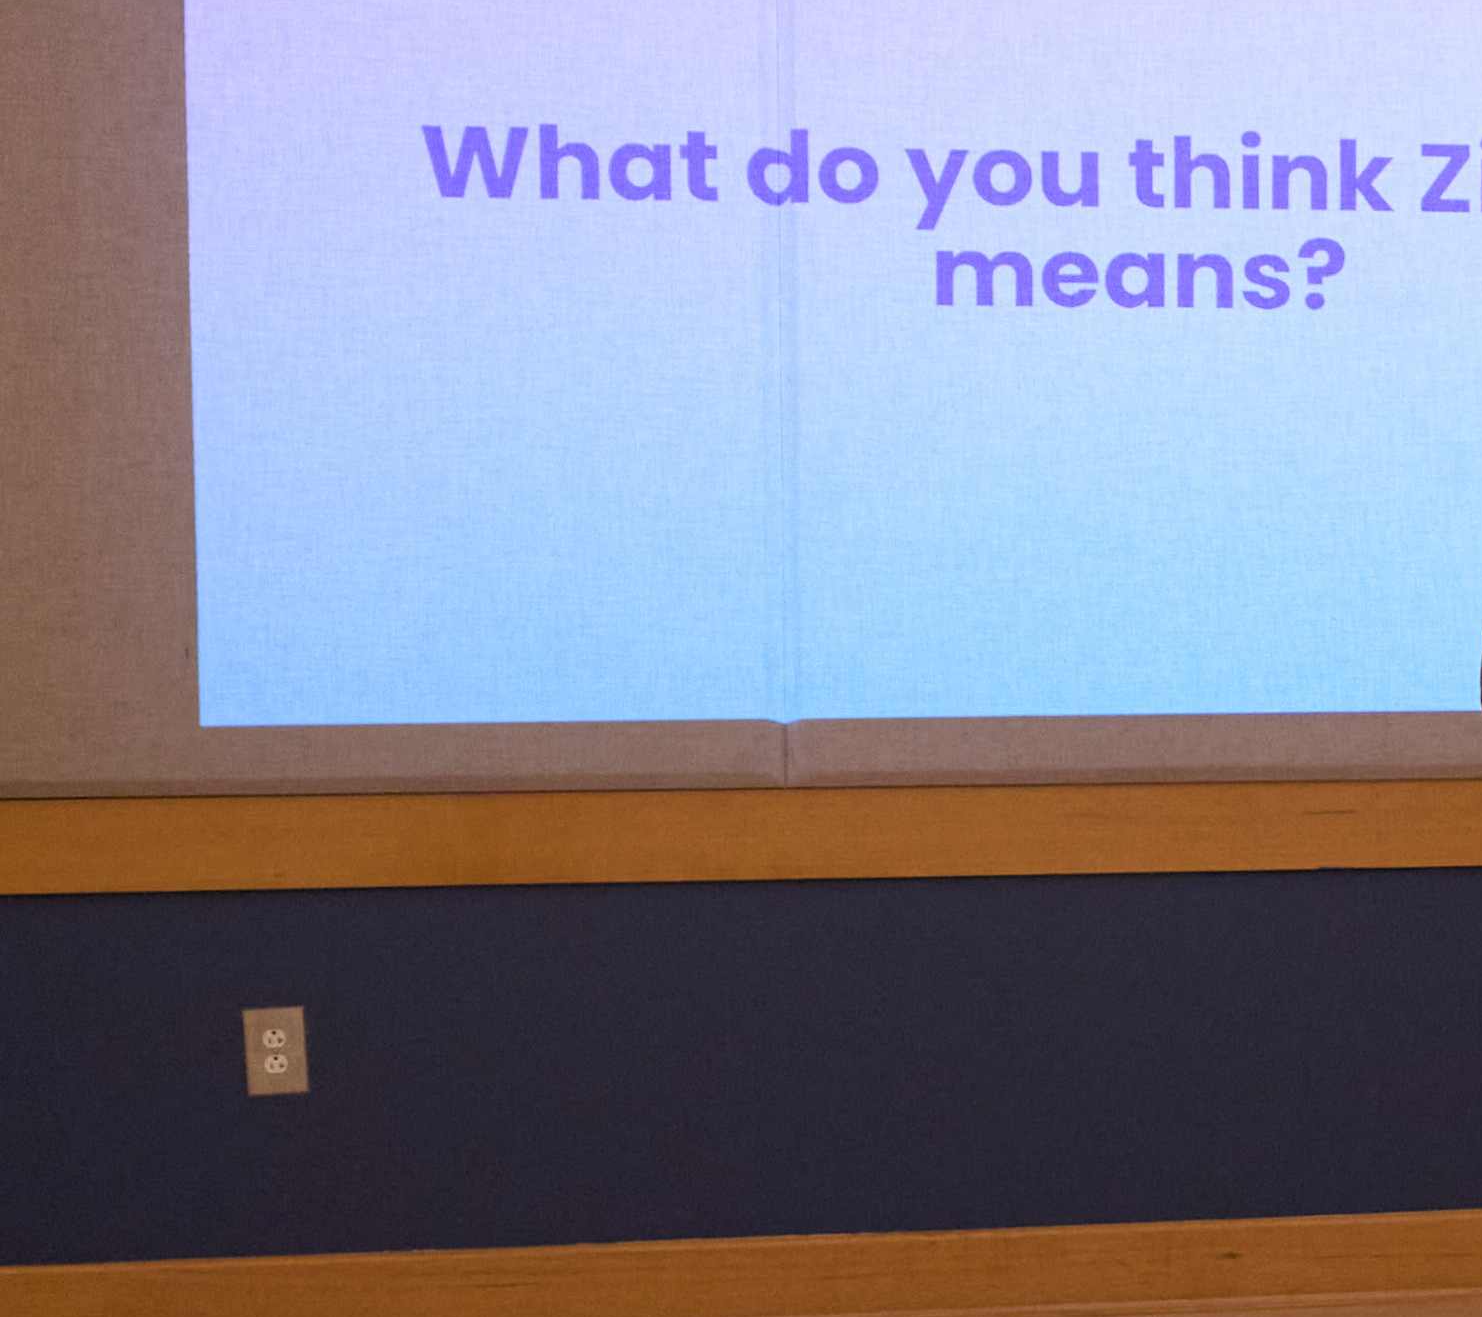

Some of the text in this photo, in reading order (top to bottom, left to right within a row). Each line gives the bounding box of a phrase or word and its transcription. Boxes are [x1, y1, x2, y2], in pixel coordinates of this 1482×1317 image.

[421, 124, 719, 202] What
[747, 128, 879, 206] do
[904, 149, 1099, 230] you
[1128, 130, 1394, 212] think
[935, 237, 1346, 311] means?
